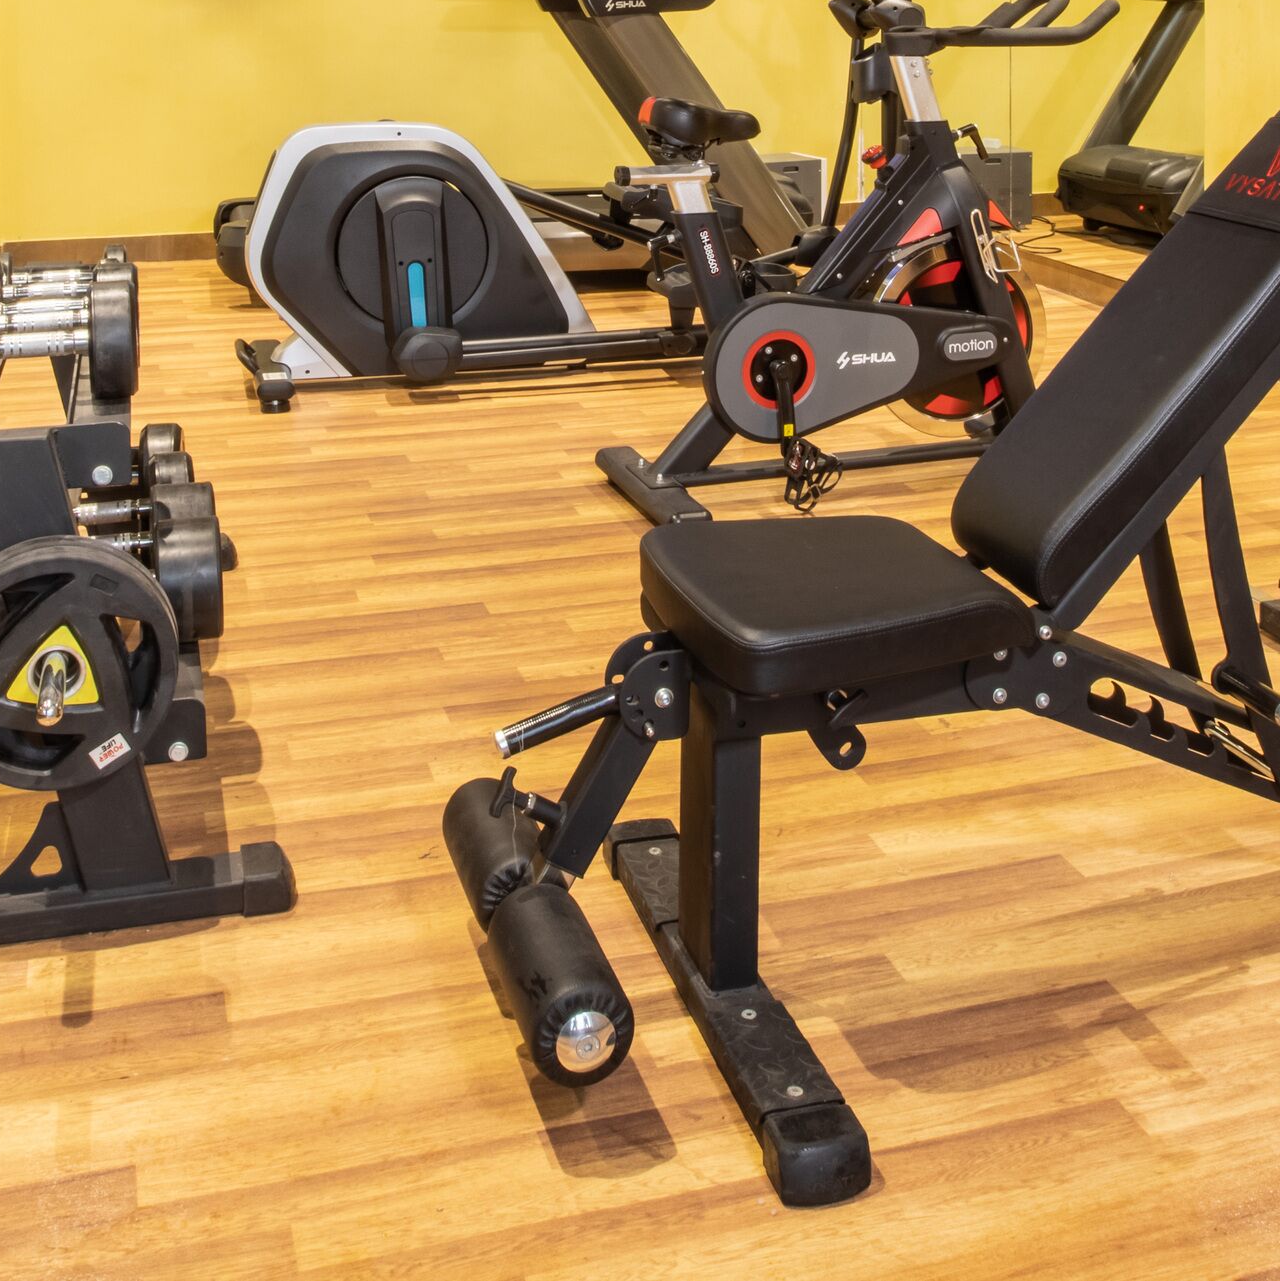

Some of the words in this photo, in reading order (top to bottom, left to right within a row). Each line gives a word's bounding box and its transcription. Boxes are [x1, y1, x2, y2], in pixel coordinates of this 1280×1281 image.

[615, 0, 646, 9] SHUA
[948, 339, 994, 354] motion
[851, 351, 896, 365] SHUA
[99, 743, 124, 762] POWER
[101, 739, 117, 752] LIFE
